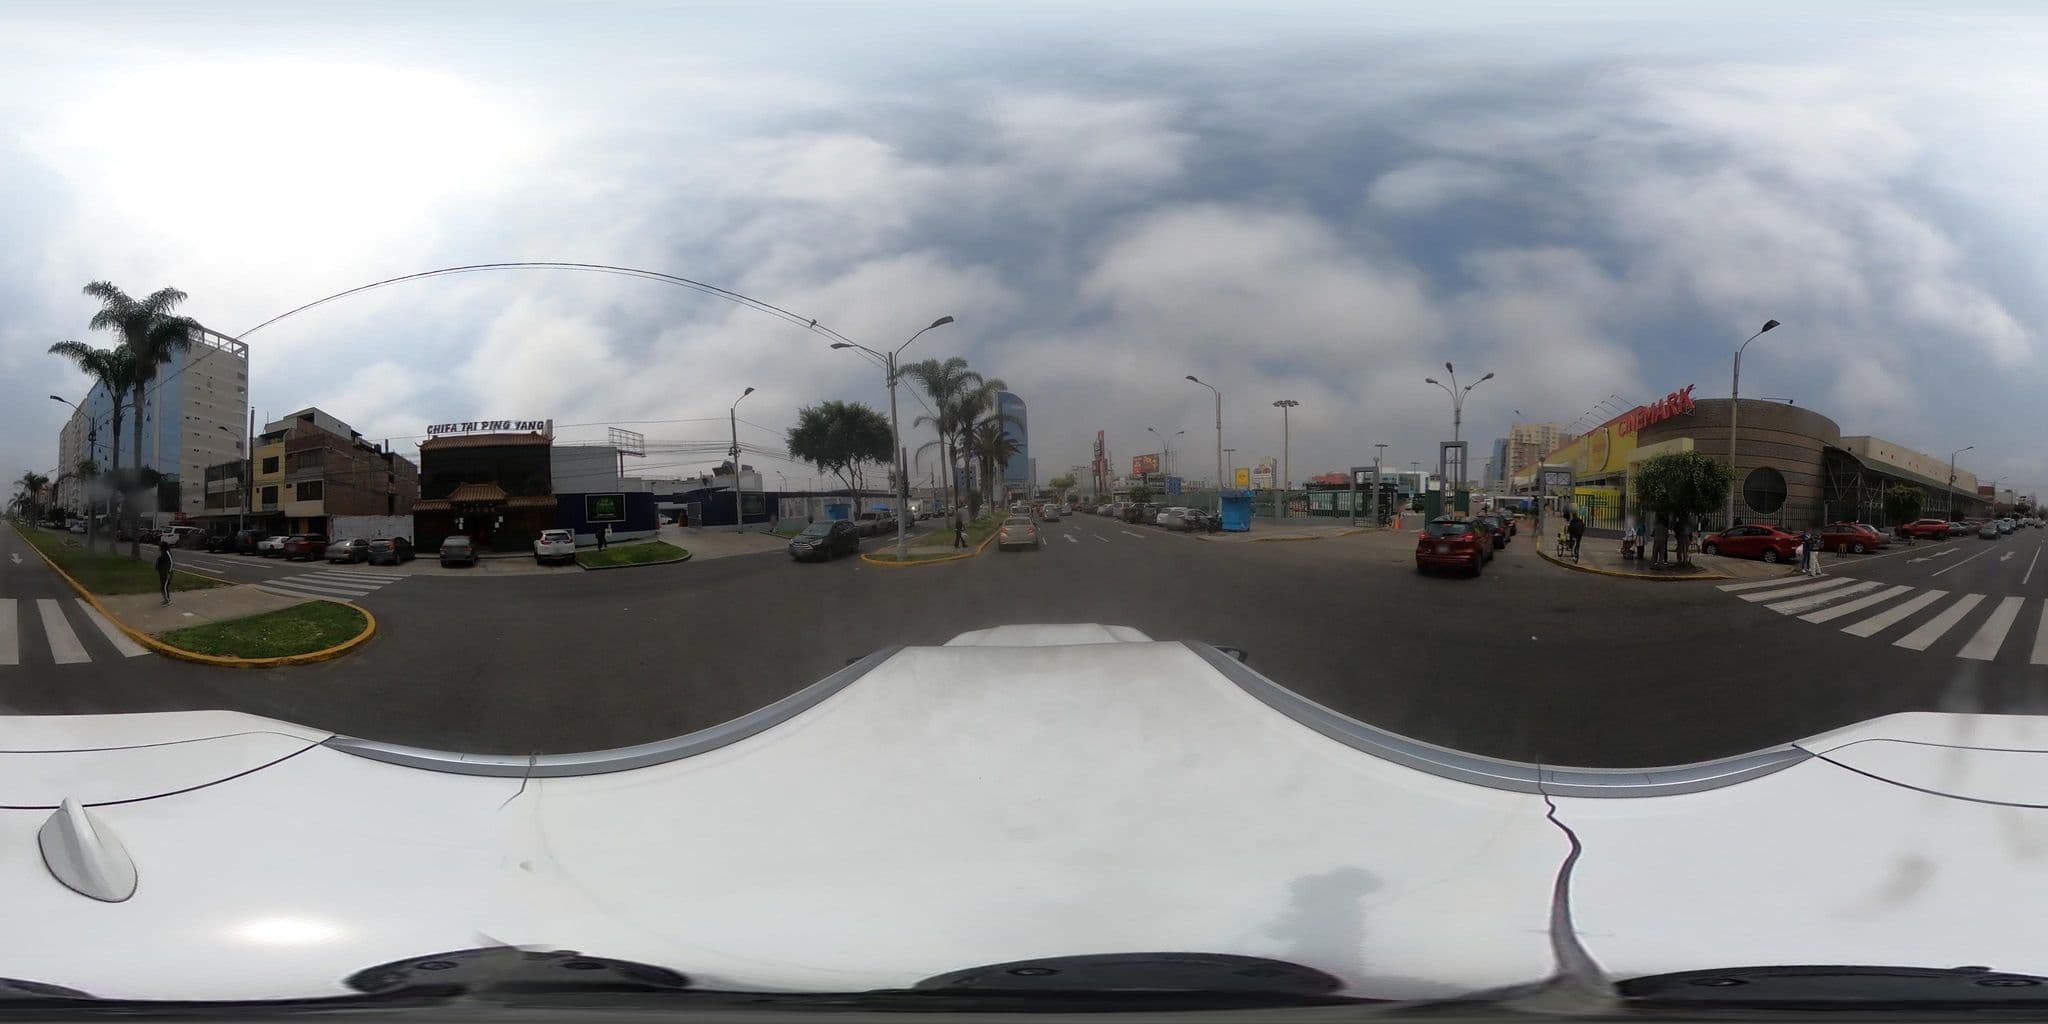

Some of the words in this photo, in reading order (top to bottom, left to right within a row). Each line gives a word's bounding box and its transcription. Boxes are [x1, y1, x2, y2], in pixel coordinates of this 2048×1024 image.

[427, 424, 457, 434] CHIFA
[461, 422, 477, 431] TAI
[481, 420, 510, 430] PING
[514, 421, 544, 430] YANG
[1619, 384, 1695, 437] CINEMARK
